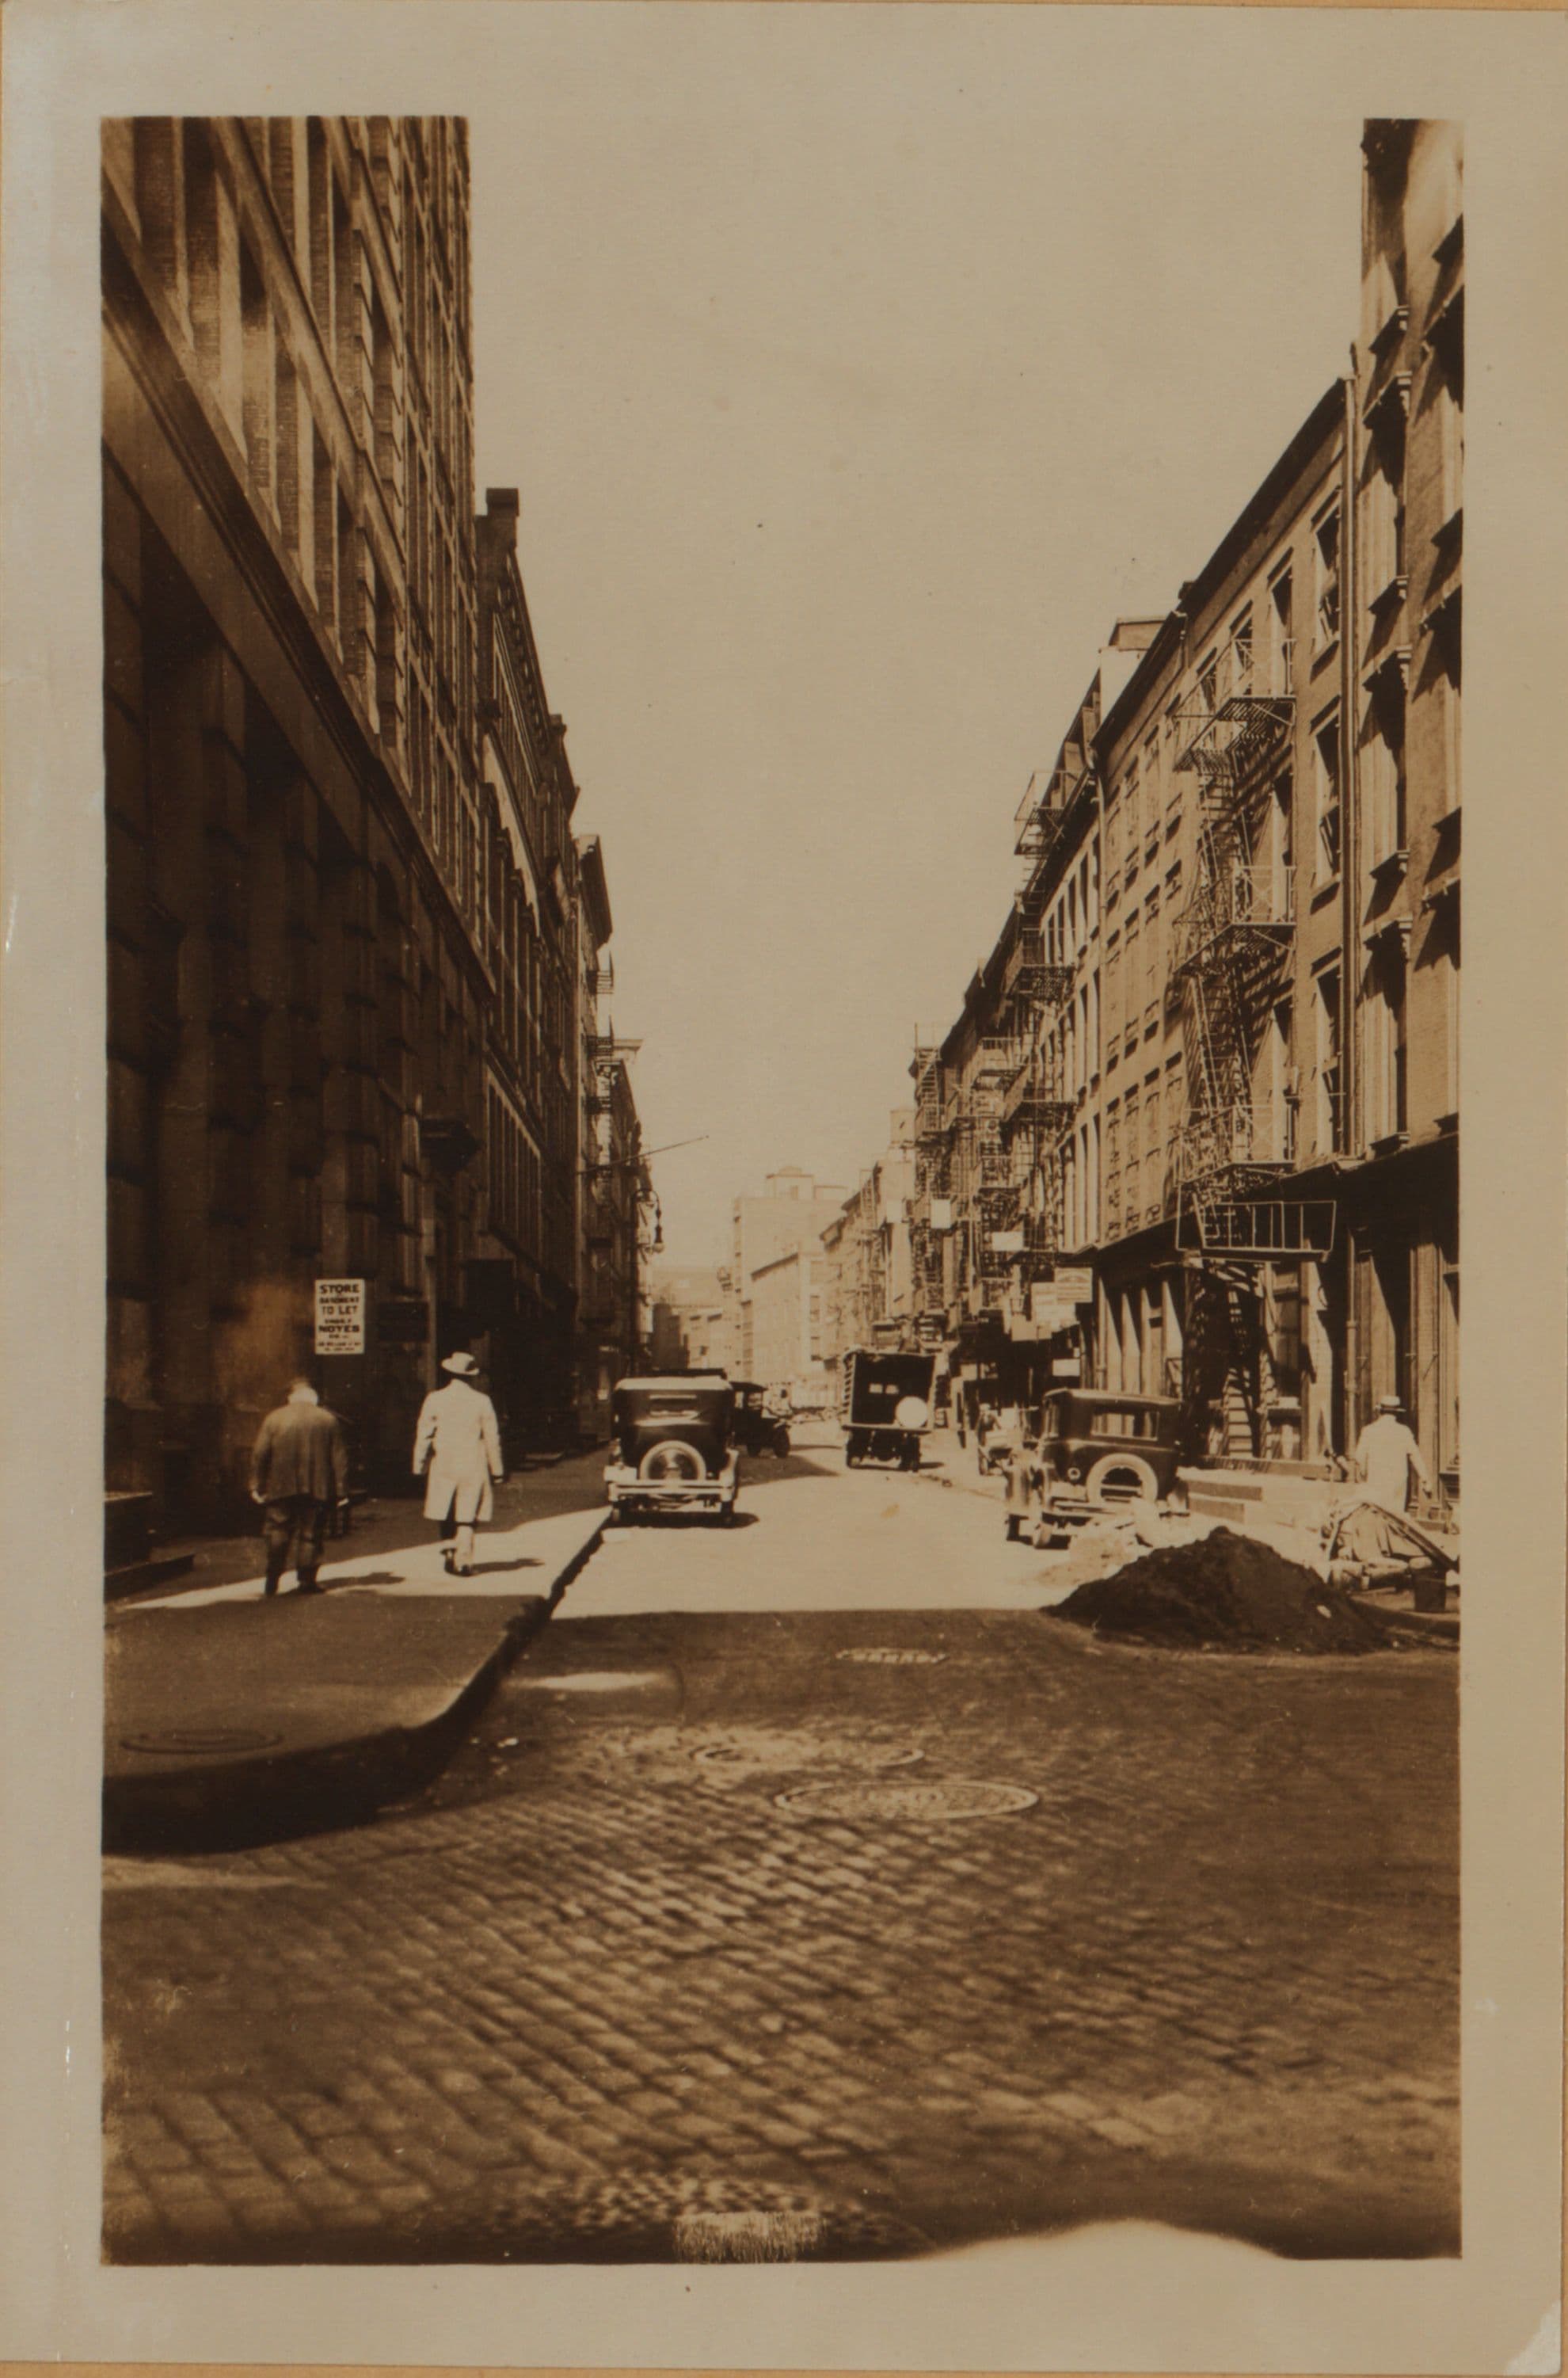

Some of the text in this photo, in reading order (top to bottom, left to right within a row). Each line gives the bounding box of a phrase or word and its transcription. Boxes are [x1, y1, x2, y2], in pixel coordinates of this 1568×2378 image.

[319, 1284, 360, 1294] STORE
[322, 1305, 358, 1315] TO LET
